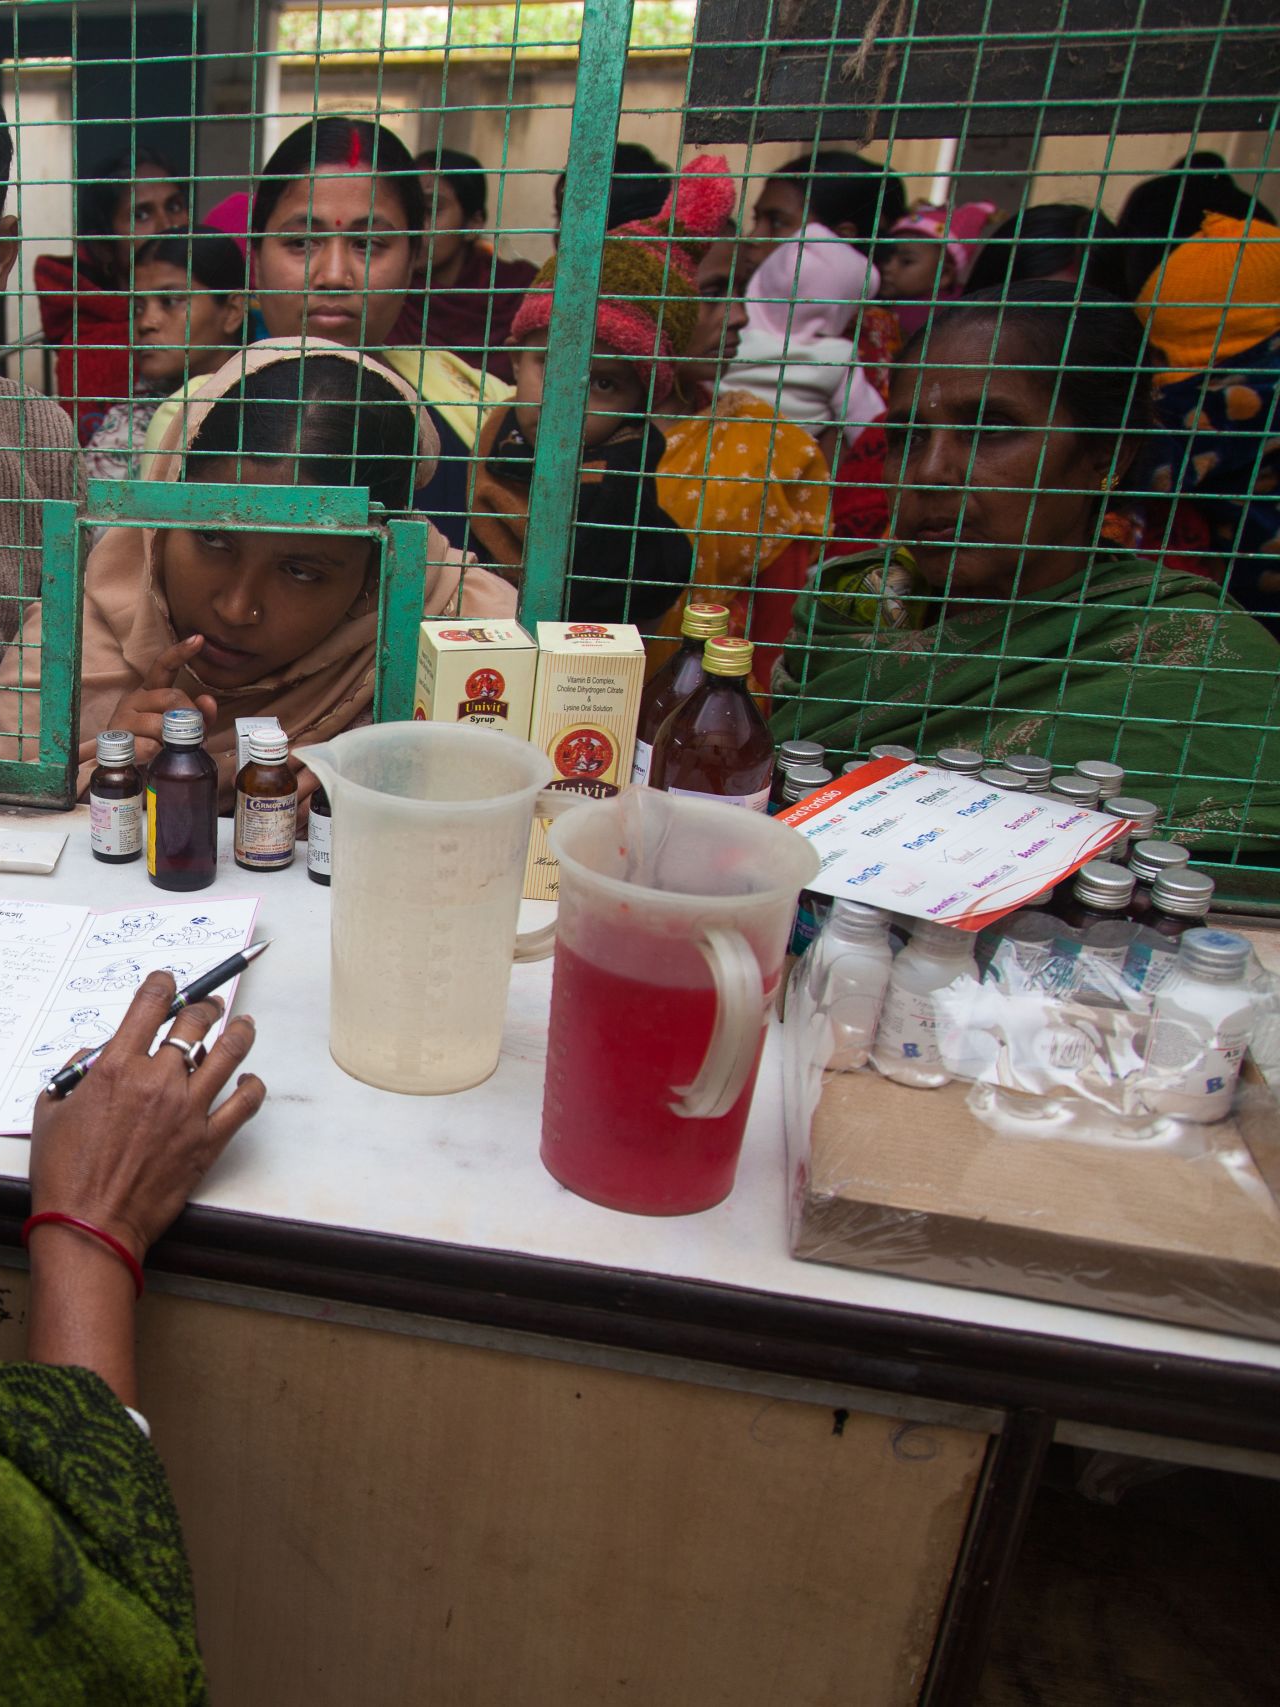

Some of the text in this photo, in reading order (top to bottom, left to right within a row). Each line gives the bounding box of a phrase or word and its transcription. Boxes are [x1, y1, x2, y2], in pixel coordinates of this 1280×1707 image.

[556, 685, 624, 695] Choline Dihydrogen Citrate
[566, 676, 586, 684] Vitamin
[592, 677, 616, 686] Complex,
[464, 701, 501, 713] Univit
[563, 703, 613, 712] Lysine Oral Solution
[469, 715, 496, 724] Syrup
[805, 789, 842, 814] Portfolio
[915, 787, 951, 806] Febrinil
[956, 796, 990, 817] FlanZen
[860, 817, 897, 837] Febrinil
[902, 829, 938, 850] FlanZen
[847, 863, 884, 886] FlanZen
